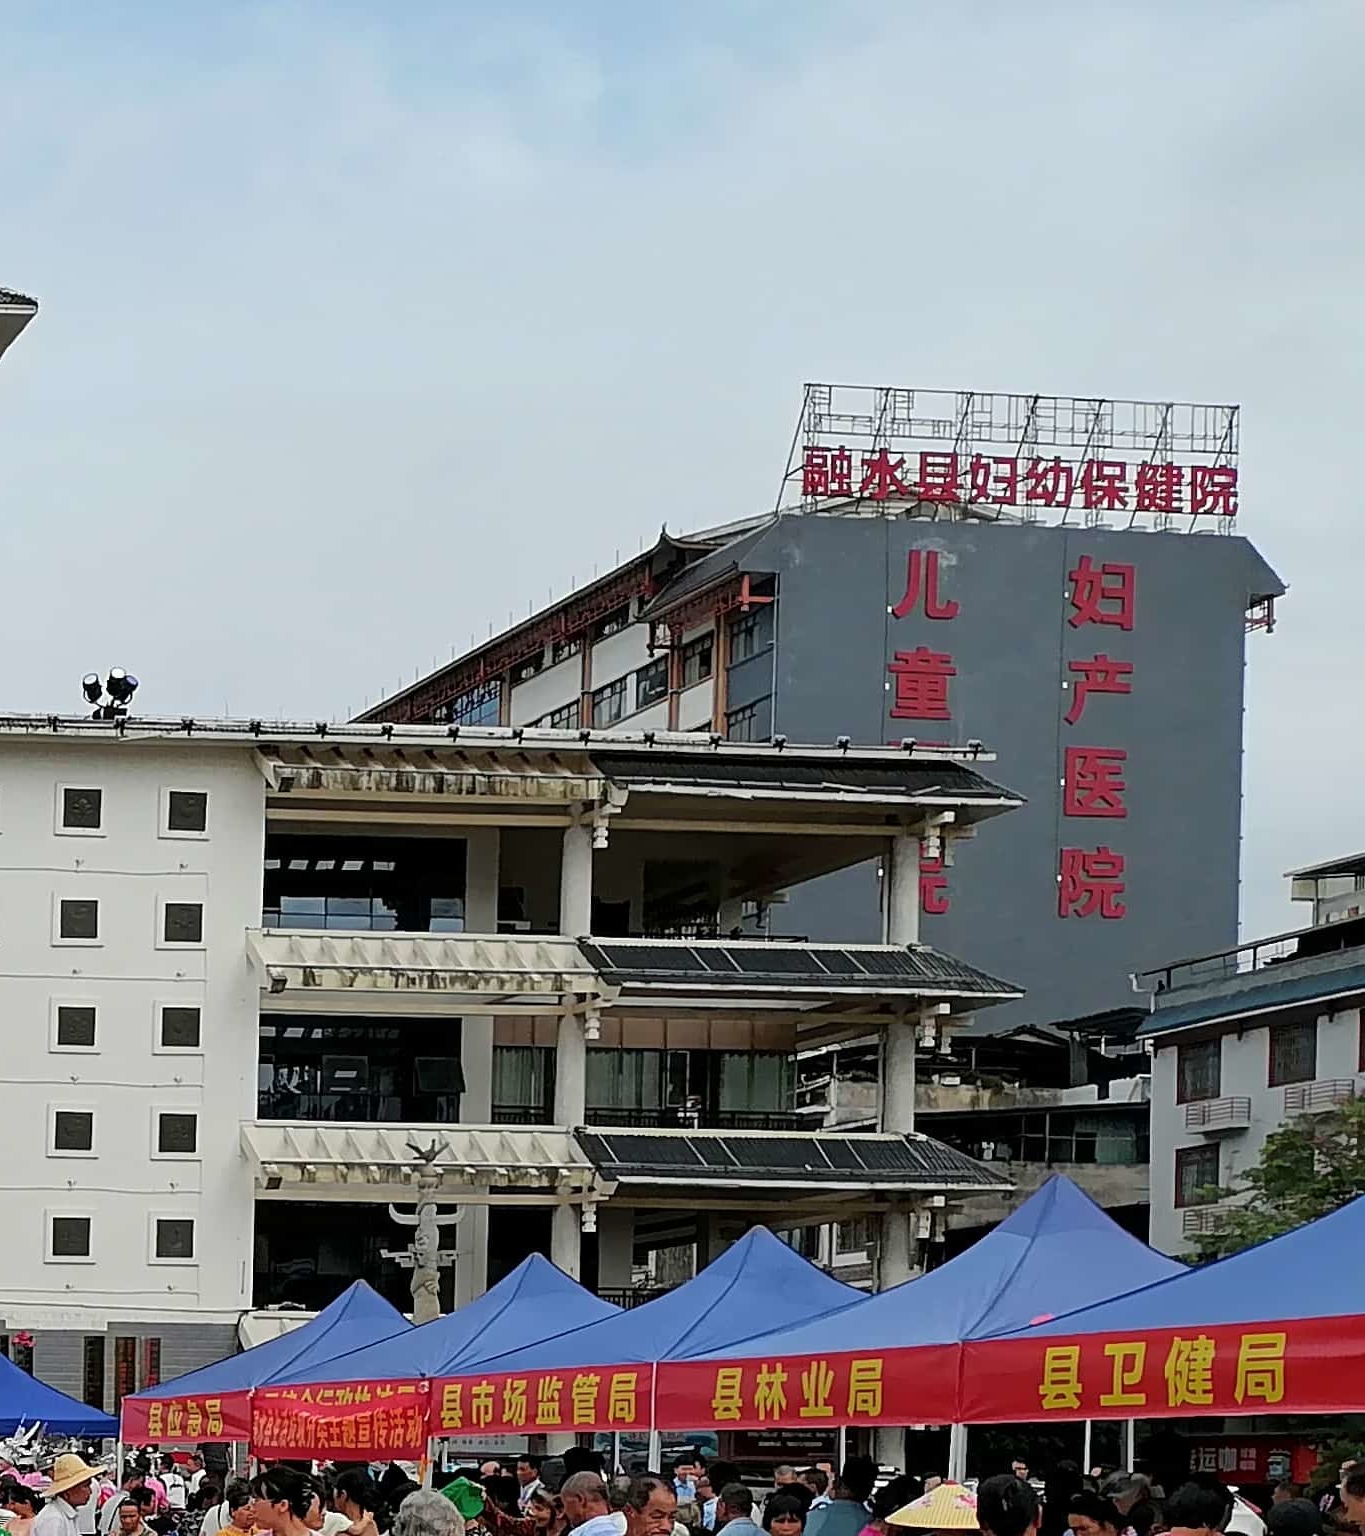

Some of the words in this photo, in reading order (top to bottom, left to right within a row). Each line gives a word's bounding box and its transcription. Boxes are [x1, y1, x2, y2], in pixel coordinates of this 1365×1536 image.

[802, 446, 1239, 516] 融水县妇幼保健院
[890, 549, 959, 915] 儿童
[1058, 554, 1138, 920] 妇产医院
[440, 1371, 638, 1428] 县市场监管局
[712, 1358, 885, 1420] 县林业局
[1038, 1331, 1287, 1409] 县卫健局
[148, 1399, 224, 1437] 县应急局
